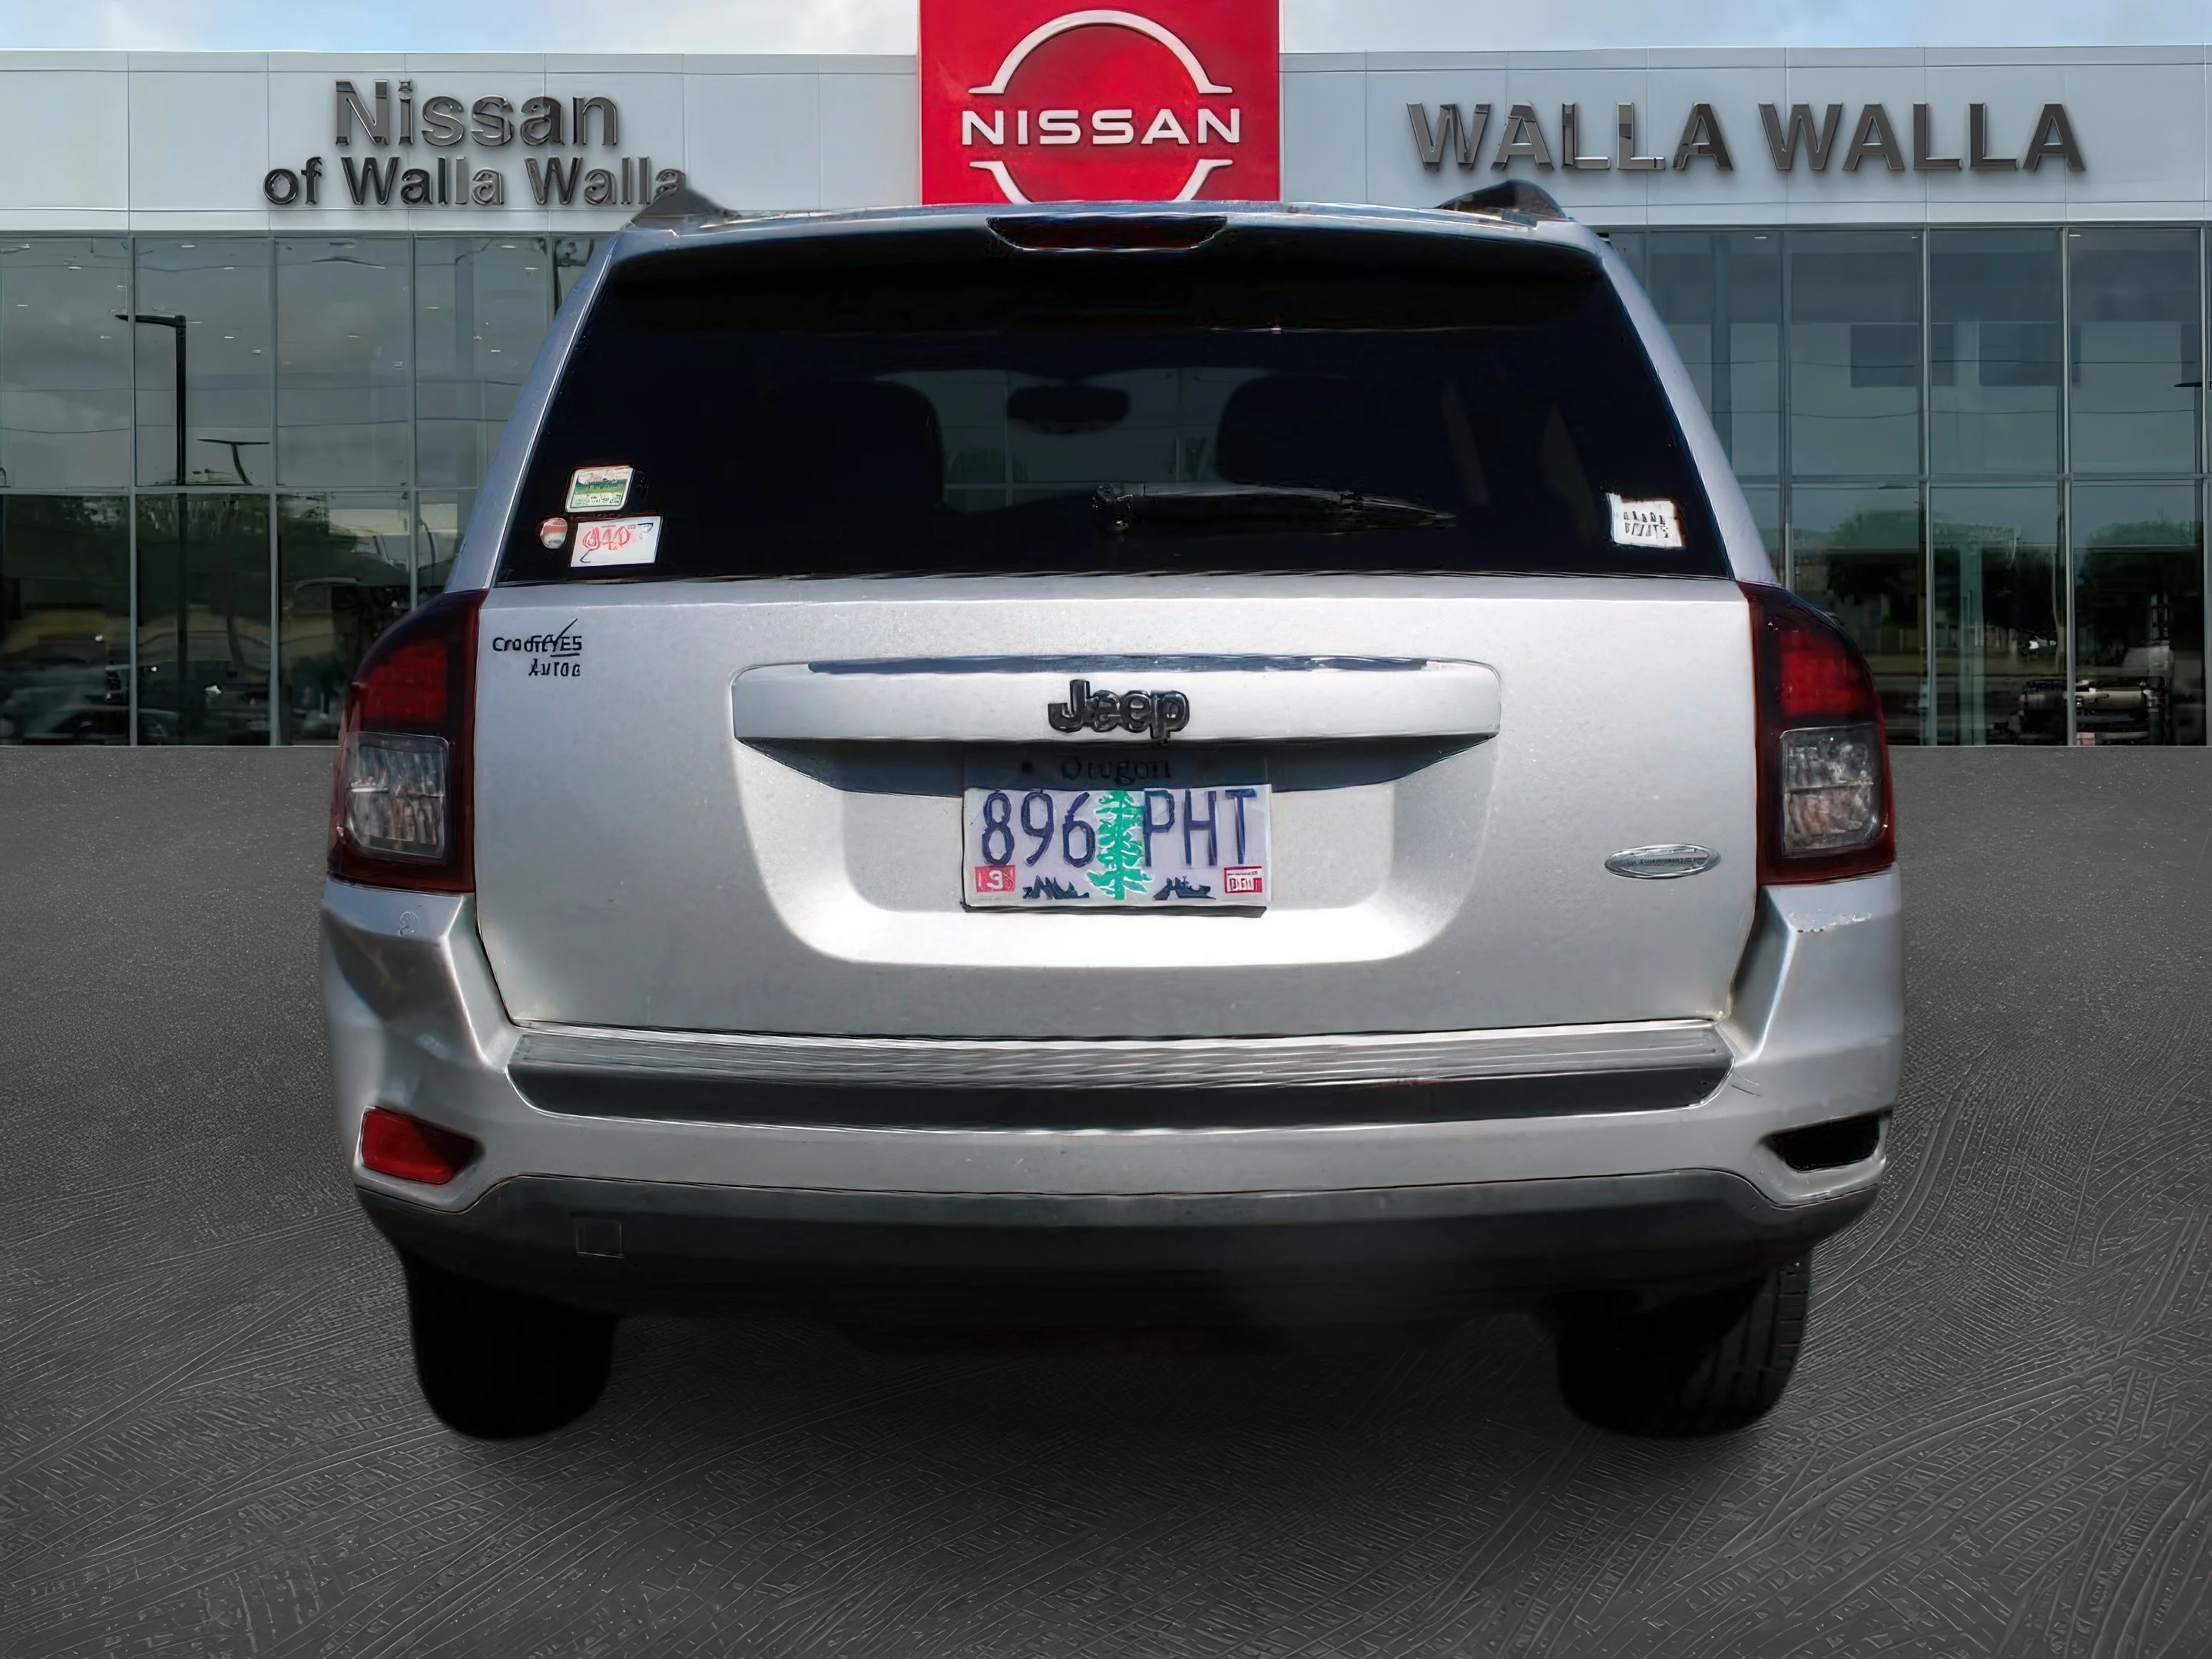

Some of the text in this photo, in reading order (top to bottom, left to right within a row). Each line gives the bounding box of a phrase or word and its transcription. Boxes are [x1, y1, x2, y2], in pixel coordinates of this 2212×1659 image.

[335, 79, 618, 146] Nissan
[962, 108, 1240, 145] NISSAN
[1406, 101, 2086, 171] WALLA WALLA
[263, 157, 686, 205] of Walla Walla
[1048, 679, 1190, 742] Jeep
[982, 788, 1257, 868] 896 PHT
